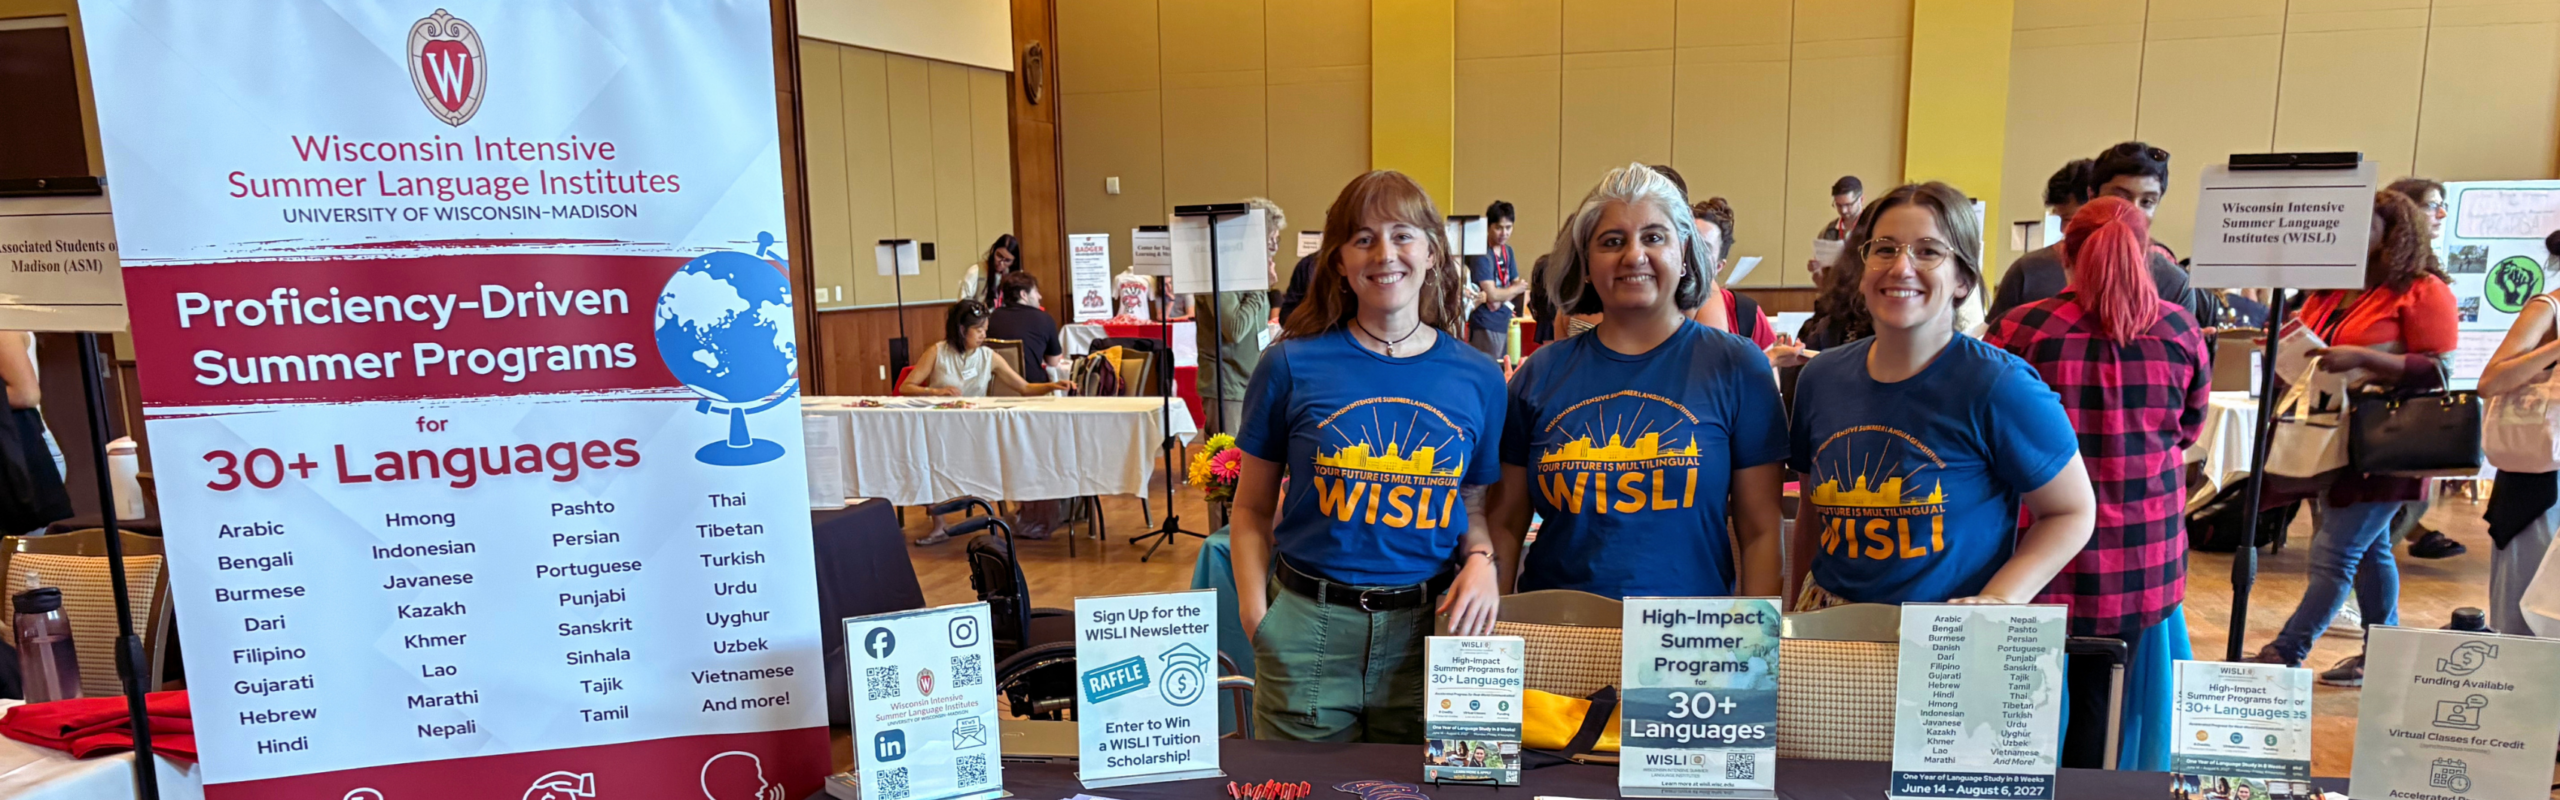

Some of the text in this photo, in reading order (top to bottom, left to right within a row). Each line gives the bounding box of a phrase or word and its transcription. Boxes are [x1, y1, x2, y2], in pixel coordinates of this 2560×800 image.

[426, 49, 467, 103] W
[292, 135, 615, 161] Wisconsin Intensive
[229, 169, 680, 201] Summer Language Institutes
[283, 208, 397, 223] UNIVERSITY
[403, 207, 428, 221] OF
[2222, 202, 2345, 212] Wisconsin Intensive
[2222, 218, 2340, 230] Summer Language
[56, 239, 105, 252] Students
[2222, 232, 2337, 245] Institutes (WISLI)
[11, 259, 103, 275] Madison (ASM)
[177, 282, 628, 330] Proficiency-Driven
[194, 343, 636, 385] Summer Programs
[416, 416, 448, 432] for
[203, 438, 640, 491] 30+ Languages
[1538, 458, 1700, 472] YOUR FUTURE IS MULTILINGUAL
[1314, 465, 1341, 477] YOUR
[1341, 470, 1378, 481] FUTURE
[1380, 473, 1389, 482] IS
[1538, 468, 1698, 514] WISLI
[708, 492, 746, 507] Thai
[1314, 476, 1457, 529] WISLI
[552, 501, 614, 516] Pashto
[386, 513, 455, 527] Hmong
[219, 521, 284, 538] Arabic
[696, 523, 763, 538] Tibetan
[537, 561, 642, 578] Portuguese
[384, 574, 473, 589] Javanese
[715, 581, 756, 595] Urdu
[216, 586, 305, 602] Burmese
[1093, 605, 1200, 624] Sign Up for the
[1642, 608, 1765, 628] High-Impact
[559, 618, 632, 636] Sanskrit
[1086, 623, 1209, 641] WISLI Newsletter
[1932, 625, 1963, 633] Bengali
[405, 634, 466, 648] Khmer
[1661, 633, 1744, 649] Summer
[233, 647, 305, 665] Filipino
[1452, 657, 1500, 665] High-Impact
[1468, 666, 1505, 674] Programs
[1654, 657, 1749, 676] Programs
[2220, 667, 2245, 675] WISLI
[692, 667, 794, 683] Vietnamese
[1089, 664, 1143, 694] RAFFLE
[1432, 674, 1519, 687] 30+ Languages
[1694, 678, 1707, 686] for
[1928, 672, 1962, 680] Gujarati
[2414, 675, 2515, 691] Funding Available
[580, 678, 623, 695] Tajik
[2209, 684, 2266, 695] High-Impact
[408, 690, 478, 709] Marathi
[702, 692, 789, 712] And more!
[890, 694, 963, 710] Wisconsin Intensive
[1667, 691, 1738, 720] 30+
[2187, 692, 2225, 701] Summer
[2227, 694, 2272, 705] Programs
[2274, 696, 2287, 705] for
[240, 709, 316, 725] Hebrew
[580, 706, 628, 722] Tamil
[876, 700, 978, 722] Summer Language Institutes
[2185, 702, 2211, 713] 30+
[2214, 704, 2290, 720] Languages
[418, 720, 476, 739] Nepali
[1106, 717, 1190, 733] Enter to Win
[1630, 718, 1766, 743] Languages
[1099, 733, 1200, 751] a WISLI Tuition
[2001, 730, 2031, 738] Uyghur
[2389, 729, 2426, 740] Virtual
[2428, 732, 2469, 744] Classes
[2471, 736, 2488, 746] for
[2490, 739, 2525, 750] Credit
[258, 736, 308, 754] Hindi
[879, 737, 901, 757] in
[1107, 750, 1190, 767] Scholarship!
[1646, 755, 1687, 766] WISLI
[2011, 758, 2035, 766] More!
[1984, 775, 2005, 783] Study
[1902, 783, 1931, 794] June
[1933, 784, 1946, 794] 14
[1956, 786, 1999, 797] August
[2001, 786, 2012, 796] 6,
[2014, 787, 2044, 796] 2027
[2389, 789, 2456, 800] Accelerated
